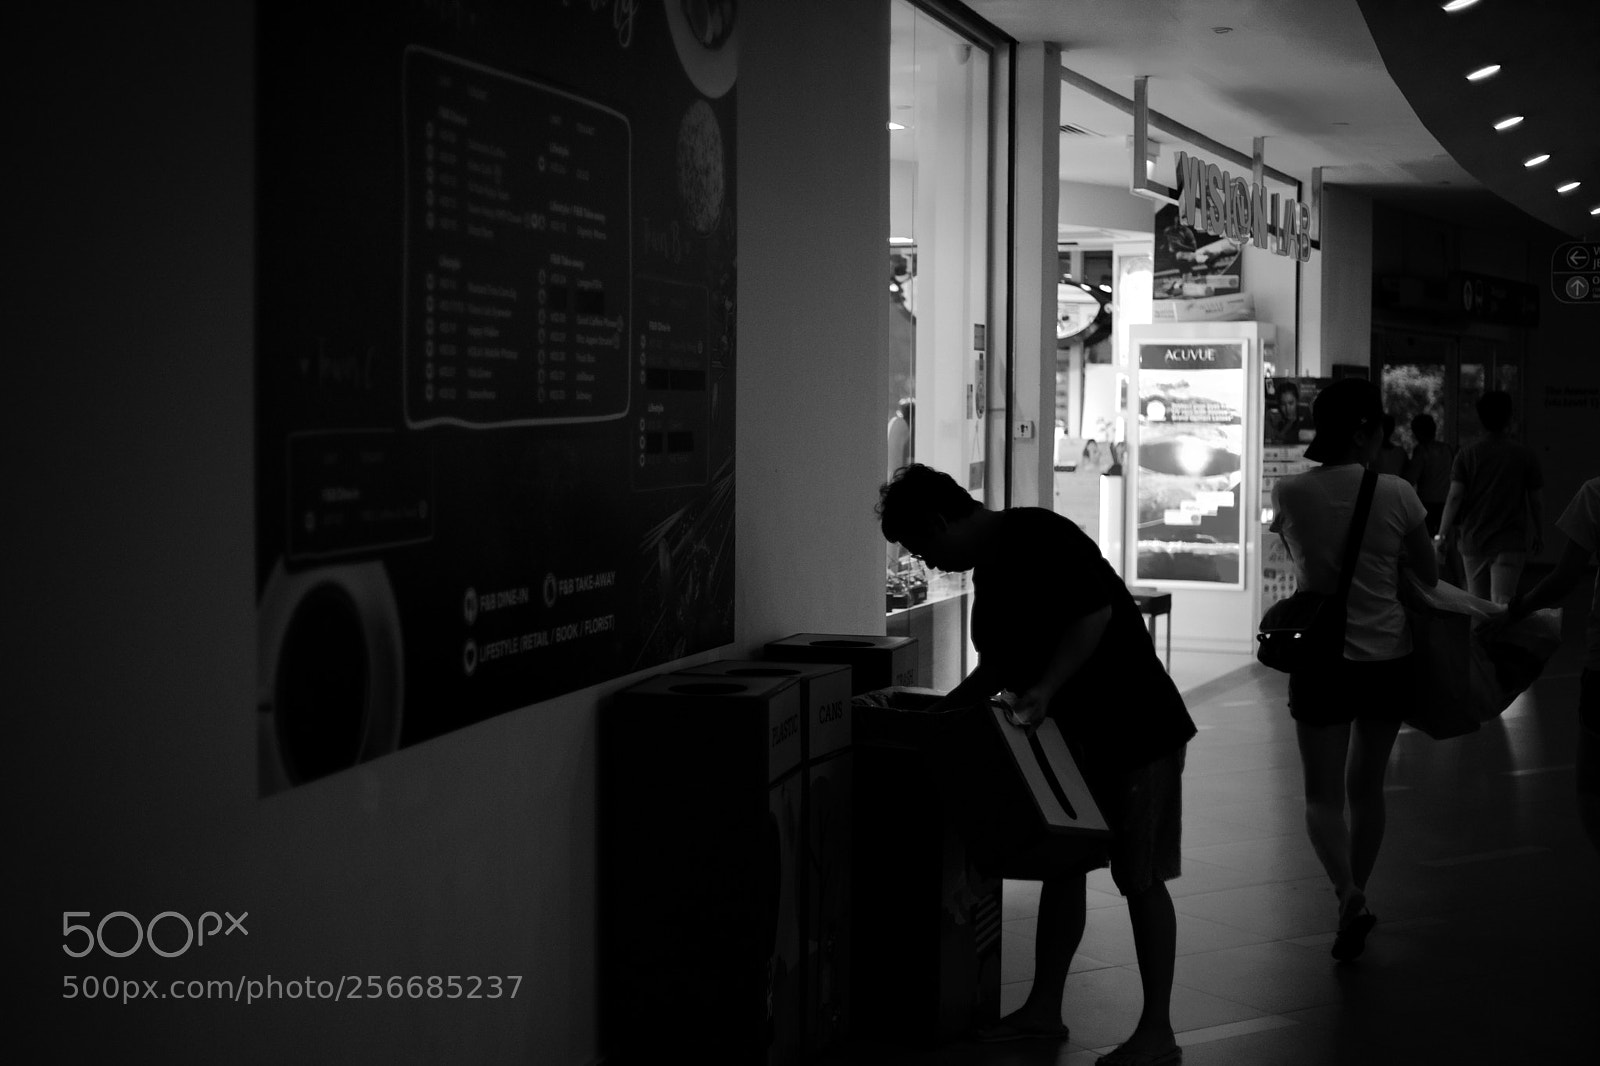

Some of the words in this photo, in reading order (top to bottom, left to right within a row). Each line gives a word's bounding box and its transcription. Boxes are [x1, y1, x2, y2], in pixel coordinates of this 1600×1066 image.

[1178, 150, 1268, 250] VISION
[1271, 192, 1311, 263] LAB
[1164, 347, 1216, 362] ACUVUE
[558, 579, 574, 596] F&B
[575, 570, 616, 593] TAKE-AWAY
[480, 593, 496, 612] F&B
[497, 587, 529, 609] DINE-IN
[479, 636, 519, 662] LIFESTYLE
[519, 630, 549, 654] (RETAIL
[556, 623, 579, 643] BOOK
[584, 613, 616, 635] FLORIST)
[818, 700, 844, 724] CANS
[771, 713, 799, 748] PLASTIC
